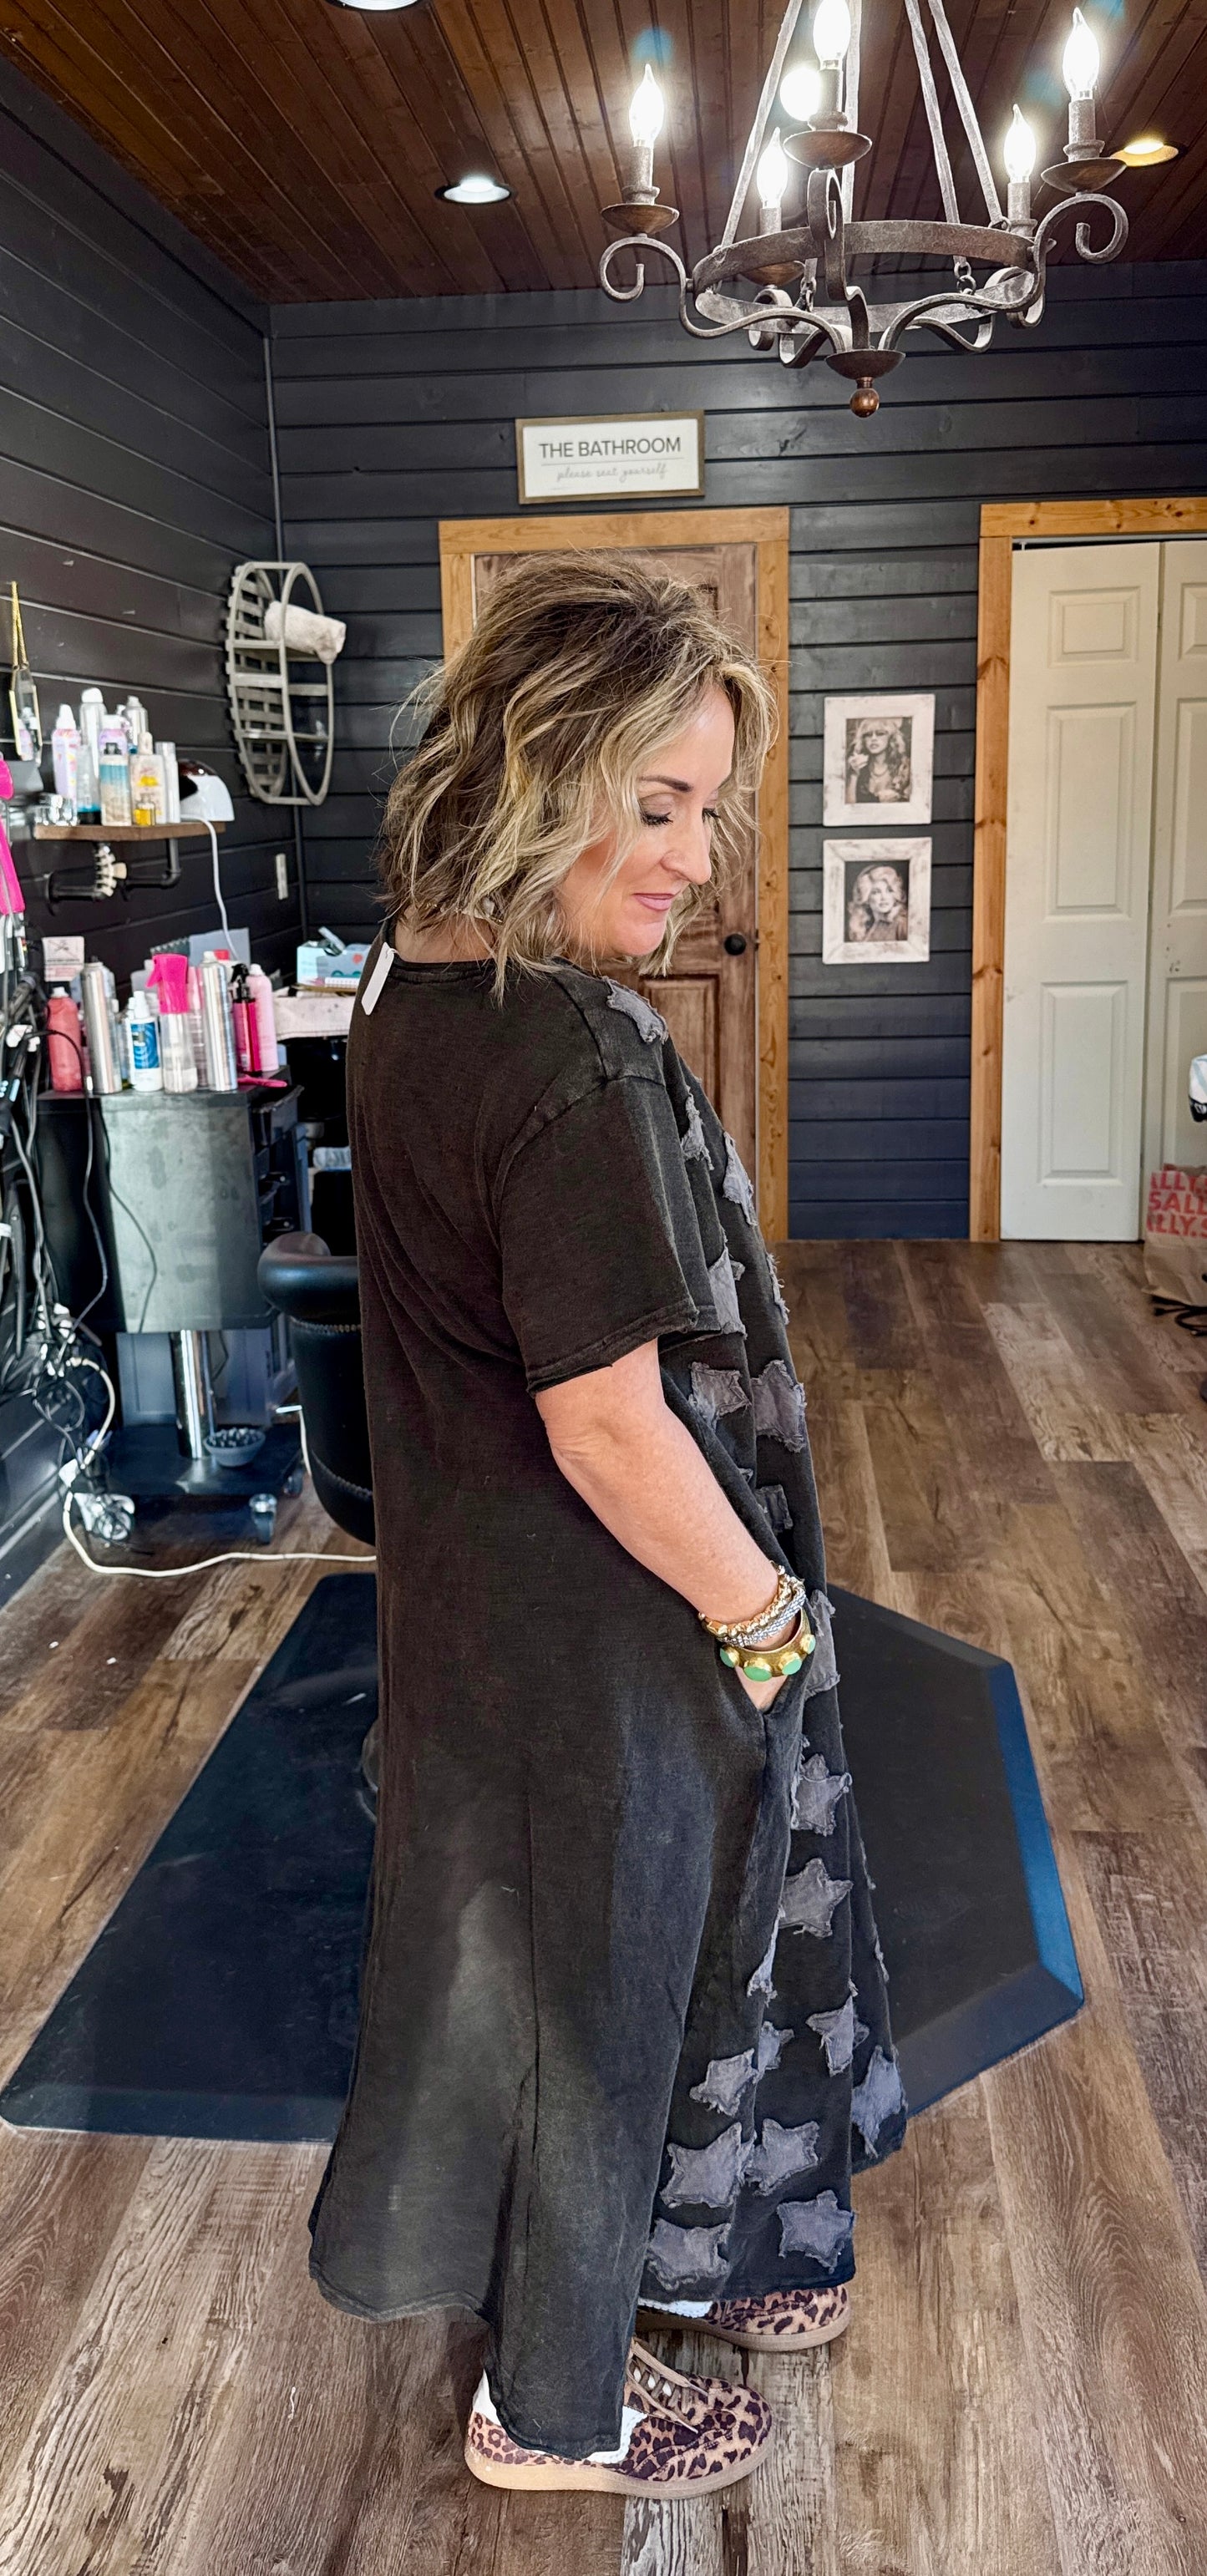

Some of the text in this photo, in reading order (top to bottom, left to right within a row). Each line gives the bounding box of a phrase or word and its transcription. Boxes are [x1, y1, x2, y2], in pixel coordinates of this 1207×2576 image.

[539, 437, 681, 459] THE BATHROOM
[556, 466, 591, 482] please
[619, 462, 667, 483] yourself
